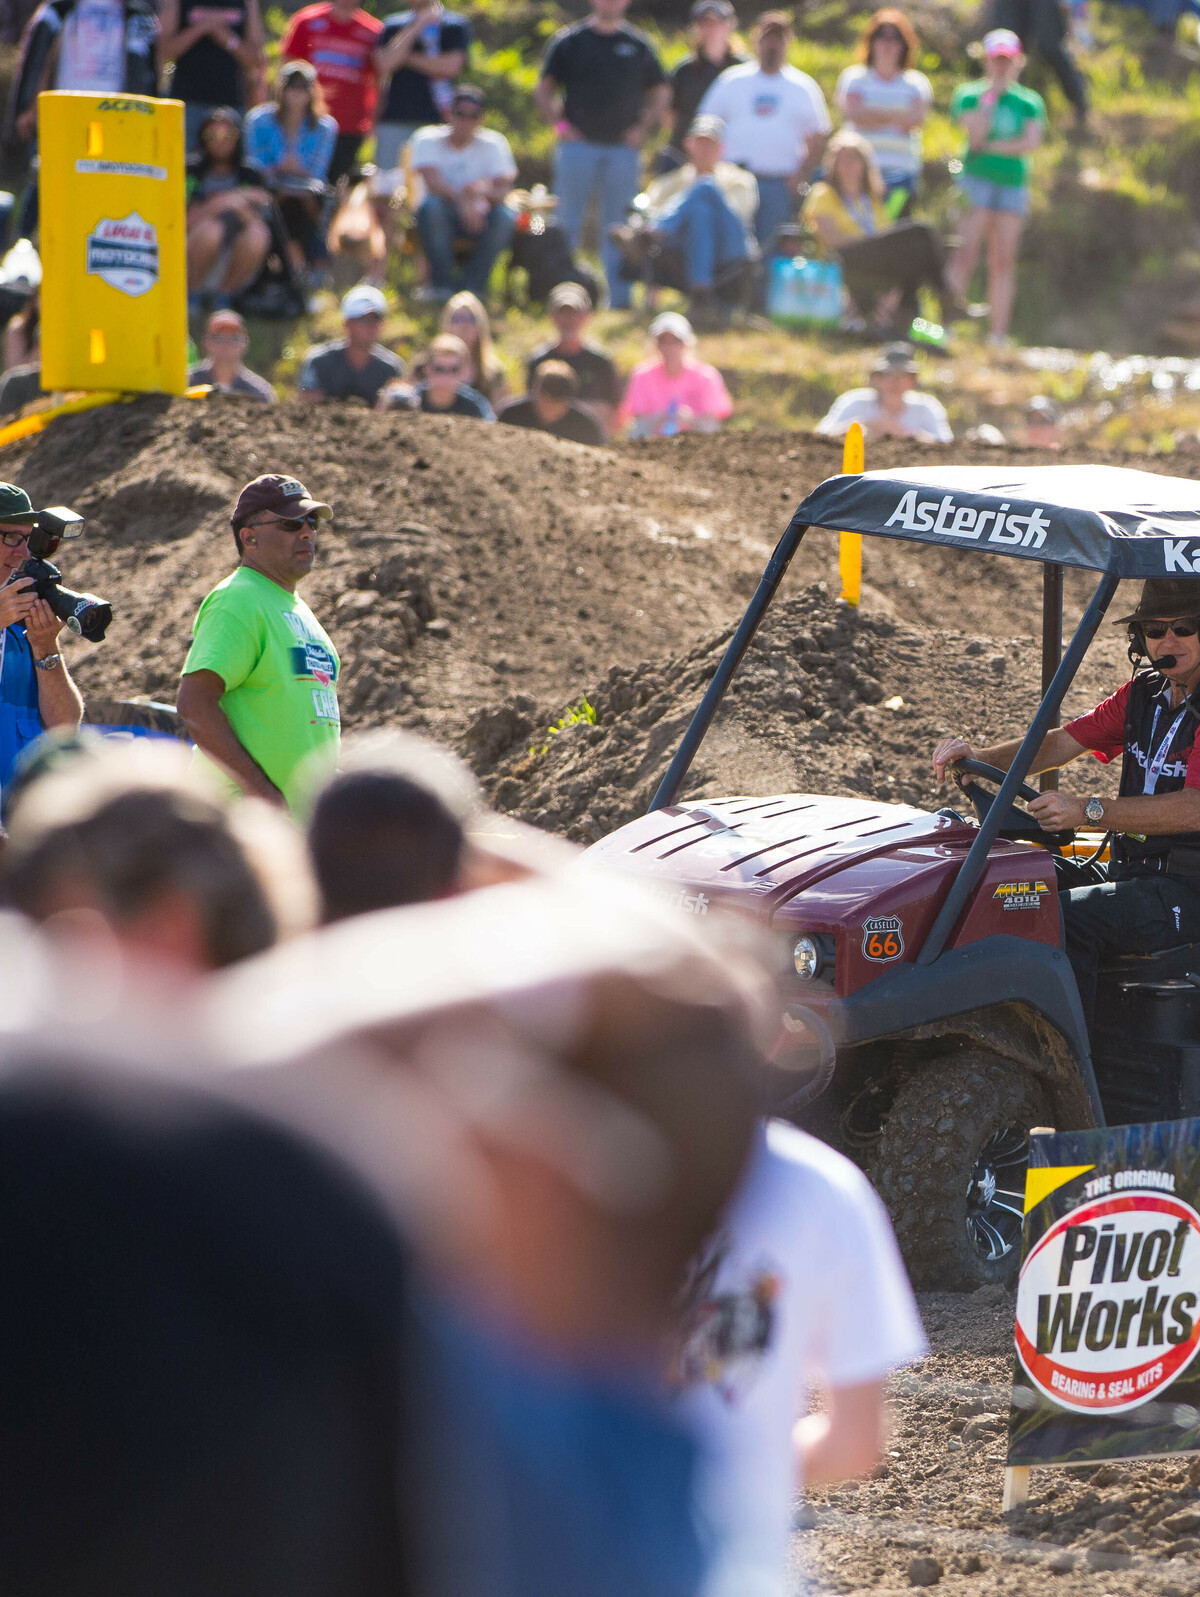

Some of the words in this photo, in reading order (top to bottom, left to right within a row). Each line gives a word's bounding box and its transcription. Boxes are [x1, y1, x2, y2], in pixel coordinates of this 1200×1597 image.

[884, 489, 1051, 549] Asterisk
[992, 881, 1050, 898] MULE
[869, 920, 896, 930] CASELLI
[869, 933, 898, 957] 66
[1085, 1174, 1112, 1198] THE
[1113, 1169, 1176, 1192] ORIGINAL
[1057, 1219, 1190, 1287] Pivot
[1035, 1286, 1197, 1355] Works
[1051, 1370, 1096, 1399] BEARING
[1097, 1383, 1106, 1400] &
[1108, 1377, 1135, 1398] SEAL
[1136, 1362, 1164, 1389] KITS
